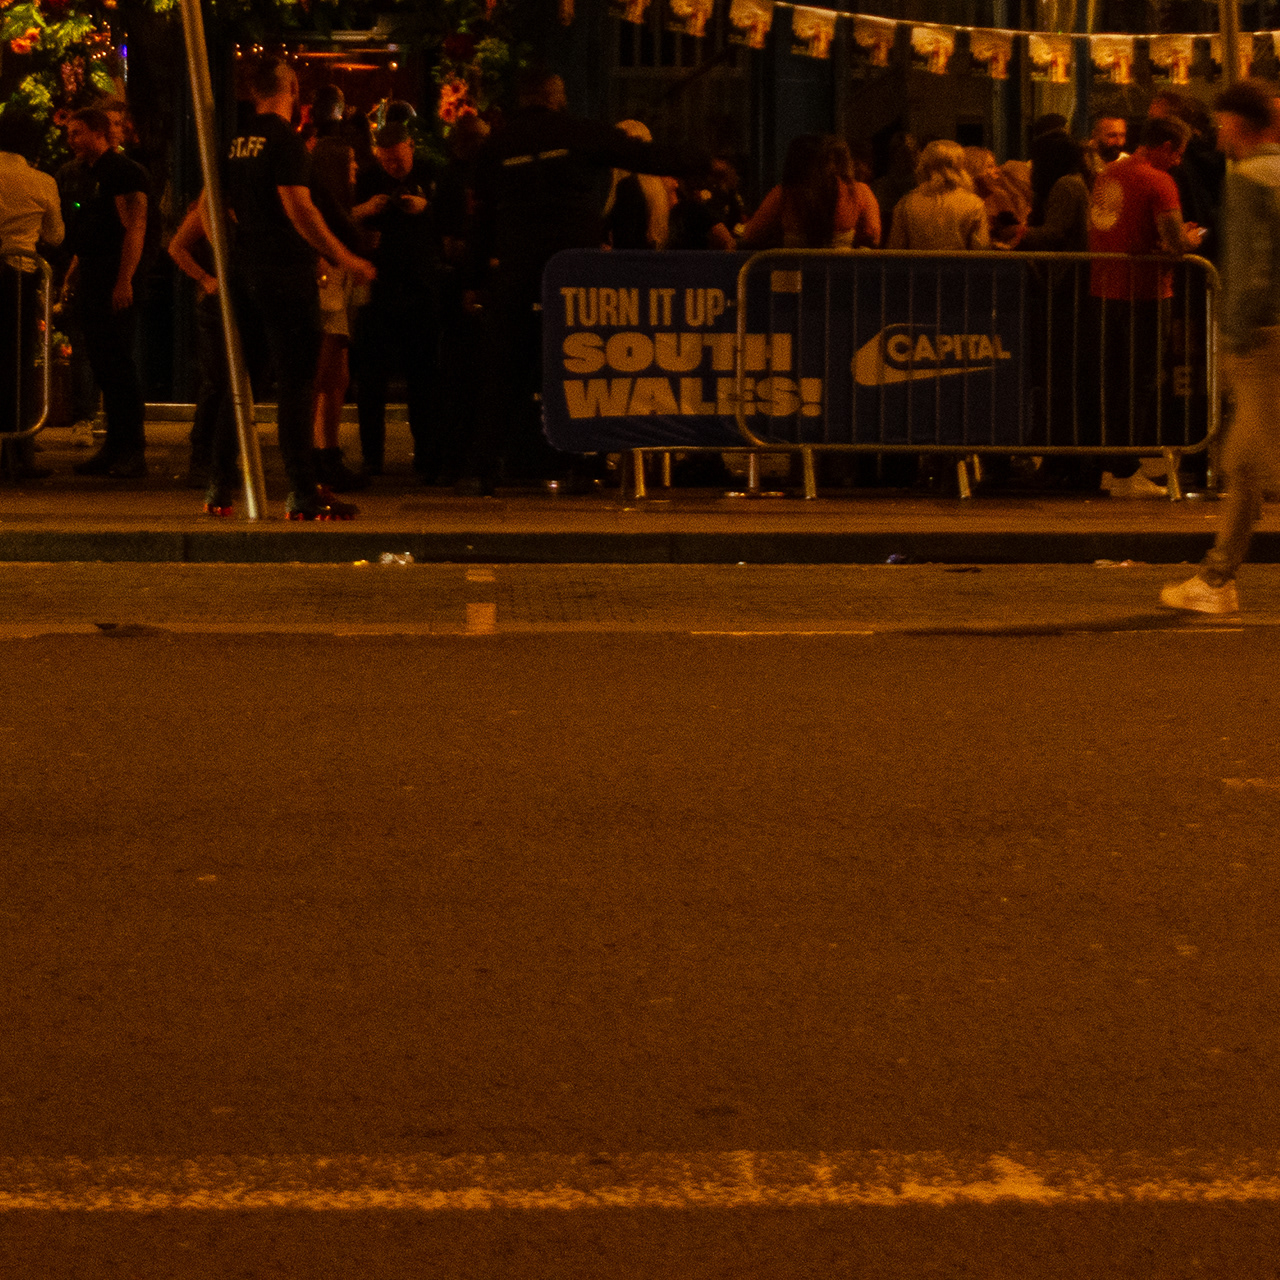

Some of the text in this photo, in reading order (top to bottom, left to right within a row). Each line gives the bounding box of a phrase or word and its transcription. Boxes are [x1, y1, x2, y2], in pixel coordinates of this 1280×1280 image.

[559, 286, 726, 328] TURN IT UP
[561, 331, 793, 374] SOUTH
[885, 333, 1012, 363] CAPITAL
[561, 376, 823, 420] WALES!
